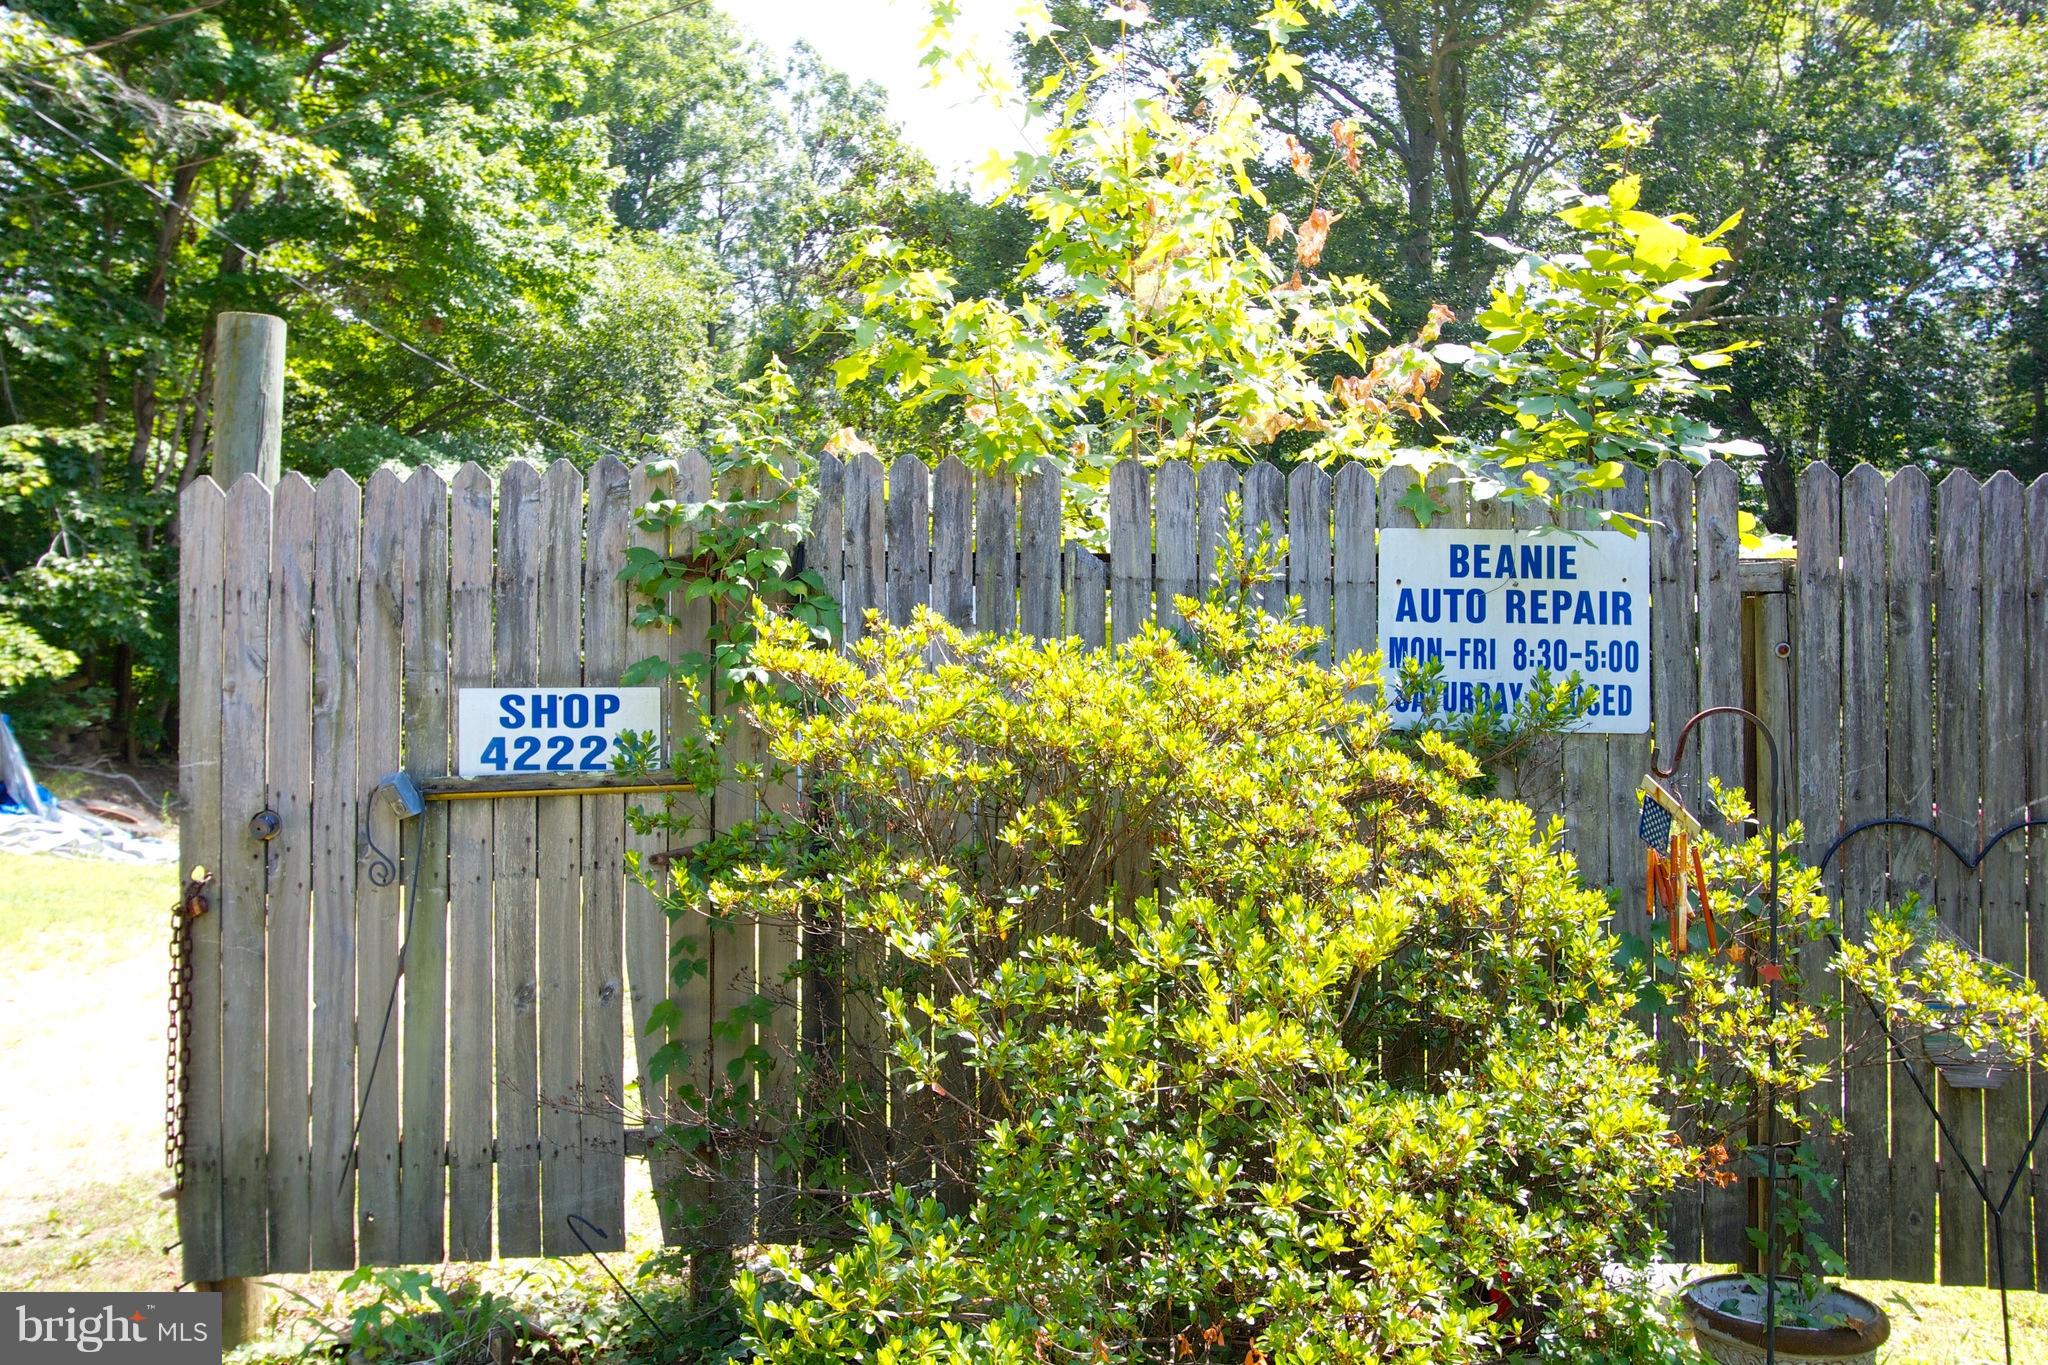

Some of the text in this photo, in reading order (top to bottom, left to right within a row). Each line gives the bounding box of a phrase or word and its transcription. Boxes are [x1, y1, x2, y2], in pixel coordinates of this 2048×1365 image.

[1449, 543, 1578, 580] BEANIE
[1395, 588, 1633, 626] AUTO REPAIR
[1389, 636, 1640, 673] MON-FRI 8:30-5:00
[499, 693, 621, 730] SHOP
[1394, 681, 1523, 714] SAURDAY
